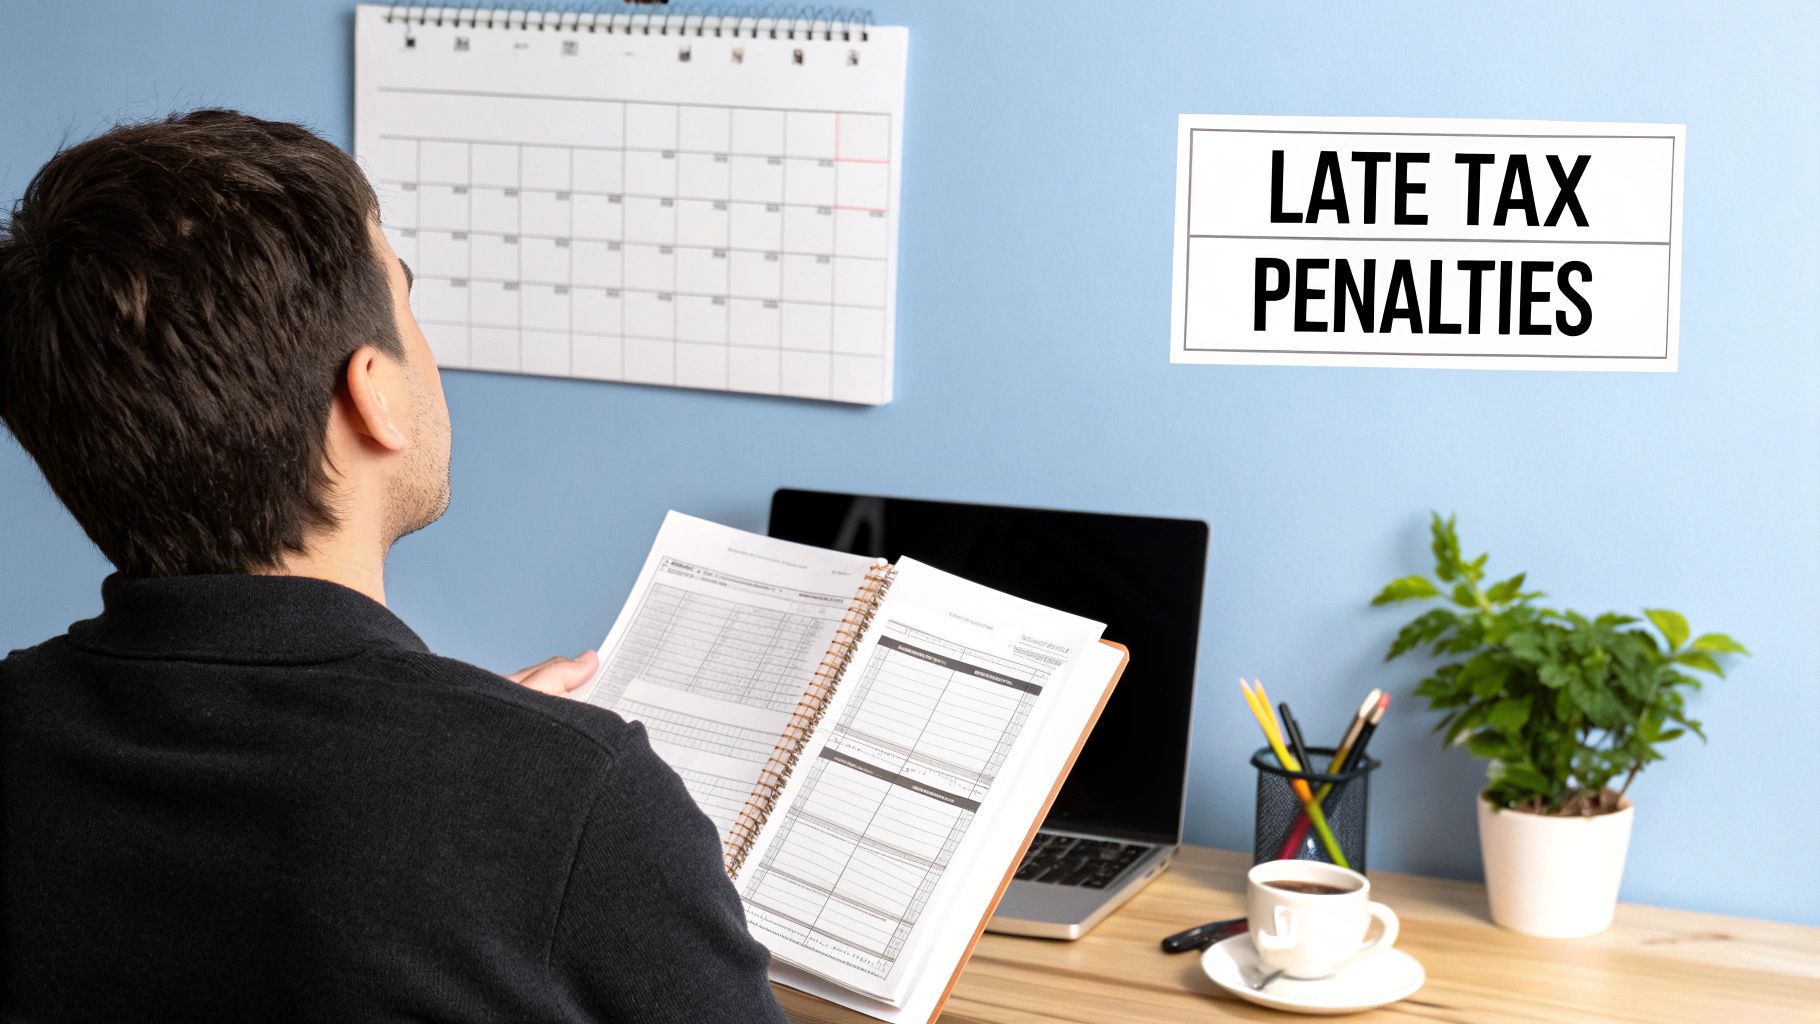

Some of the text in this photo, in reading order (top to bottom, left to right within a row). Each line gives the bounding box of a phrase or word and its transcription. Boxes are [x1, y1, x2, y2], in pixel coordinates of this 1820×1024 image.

[1270, 150, 1592, 227] LATE TAX
[1253, 257, 1593, 337] PENALTIES
